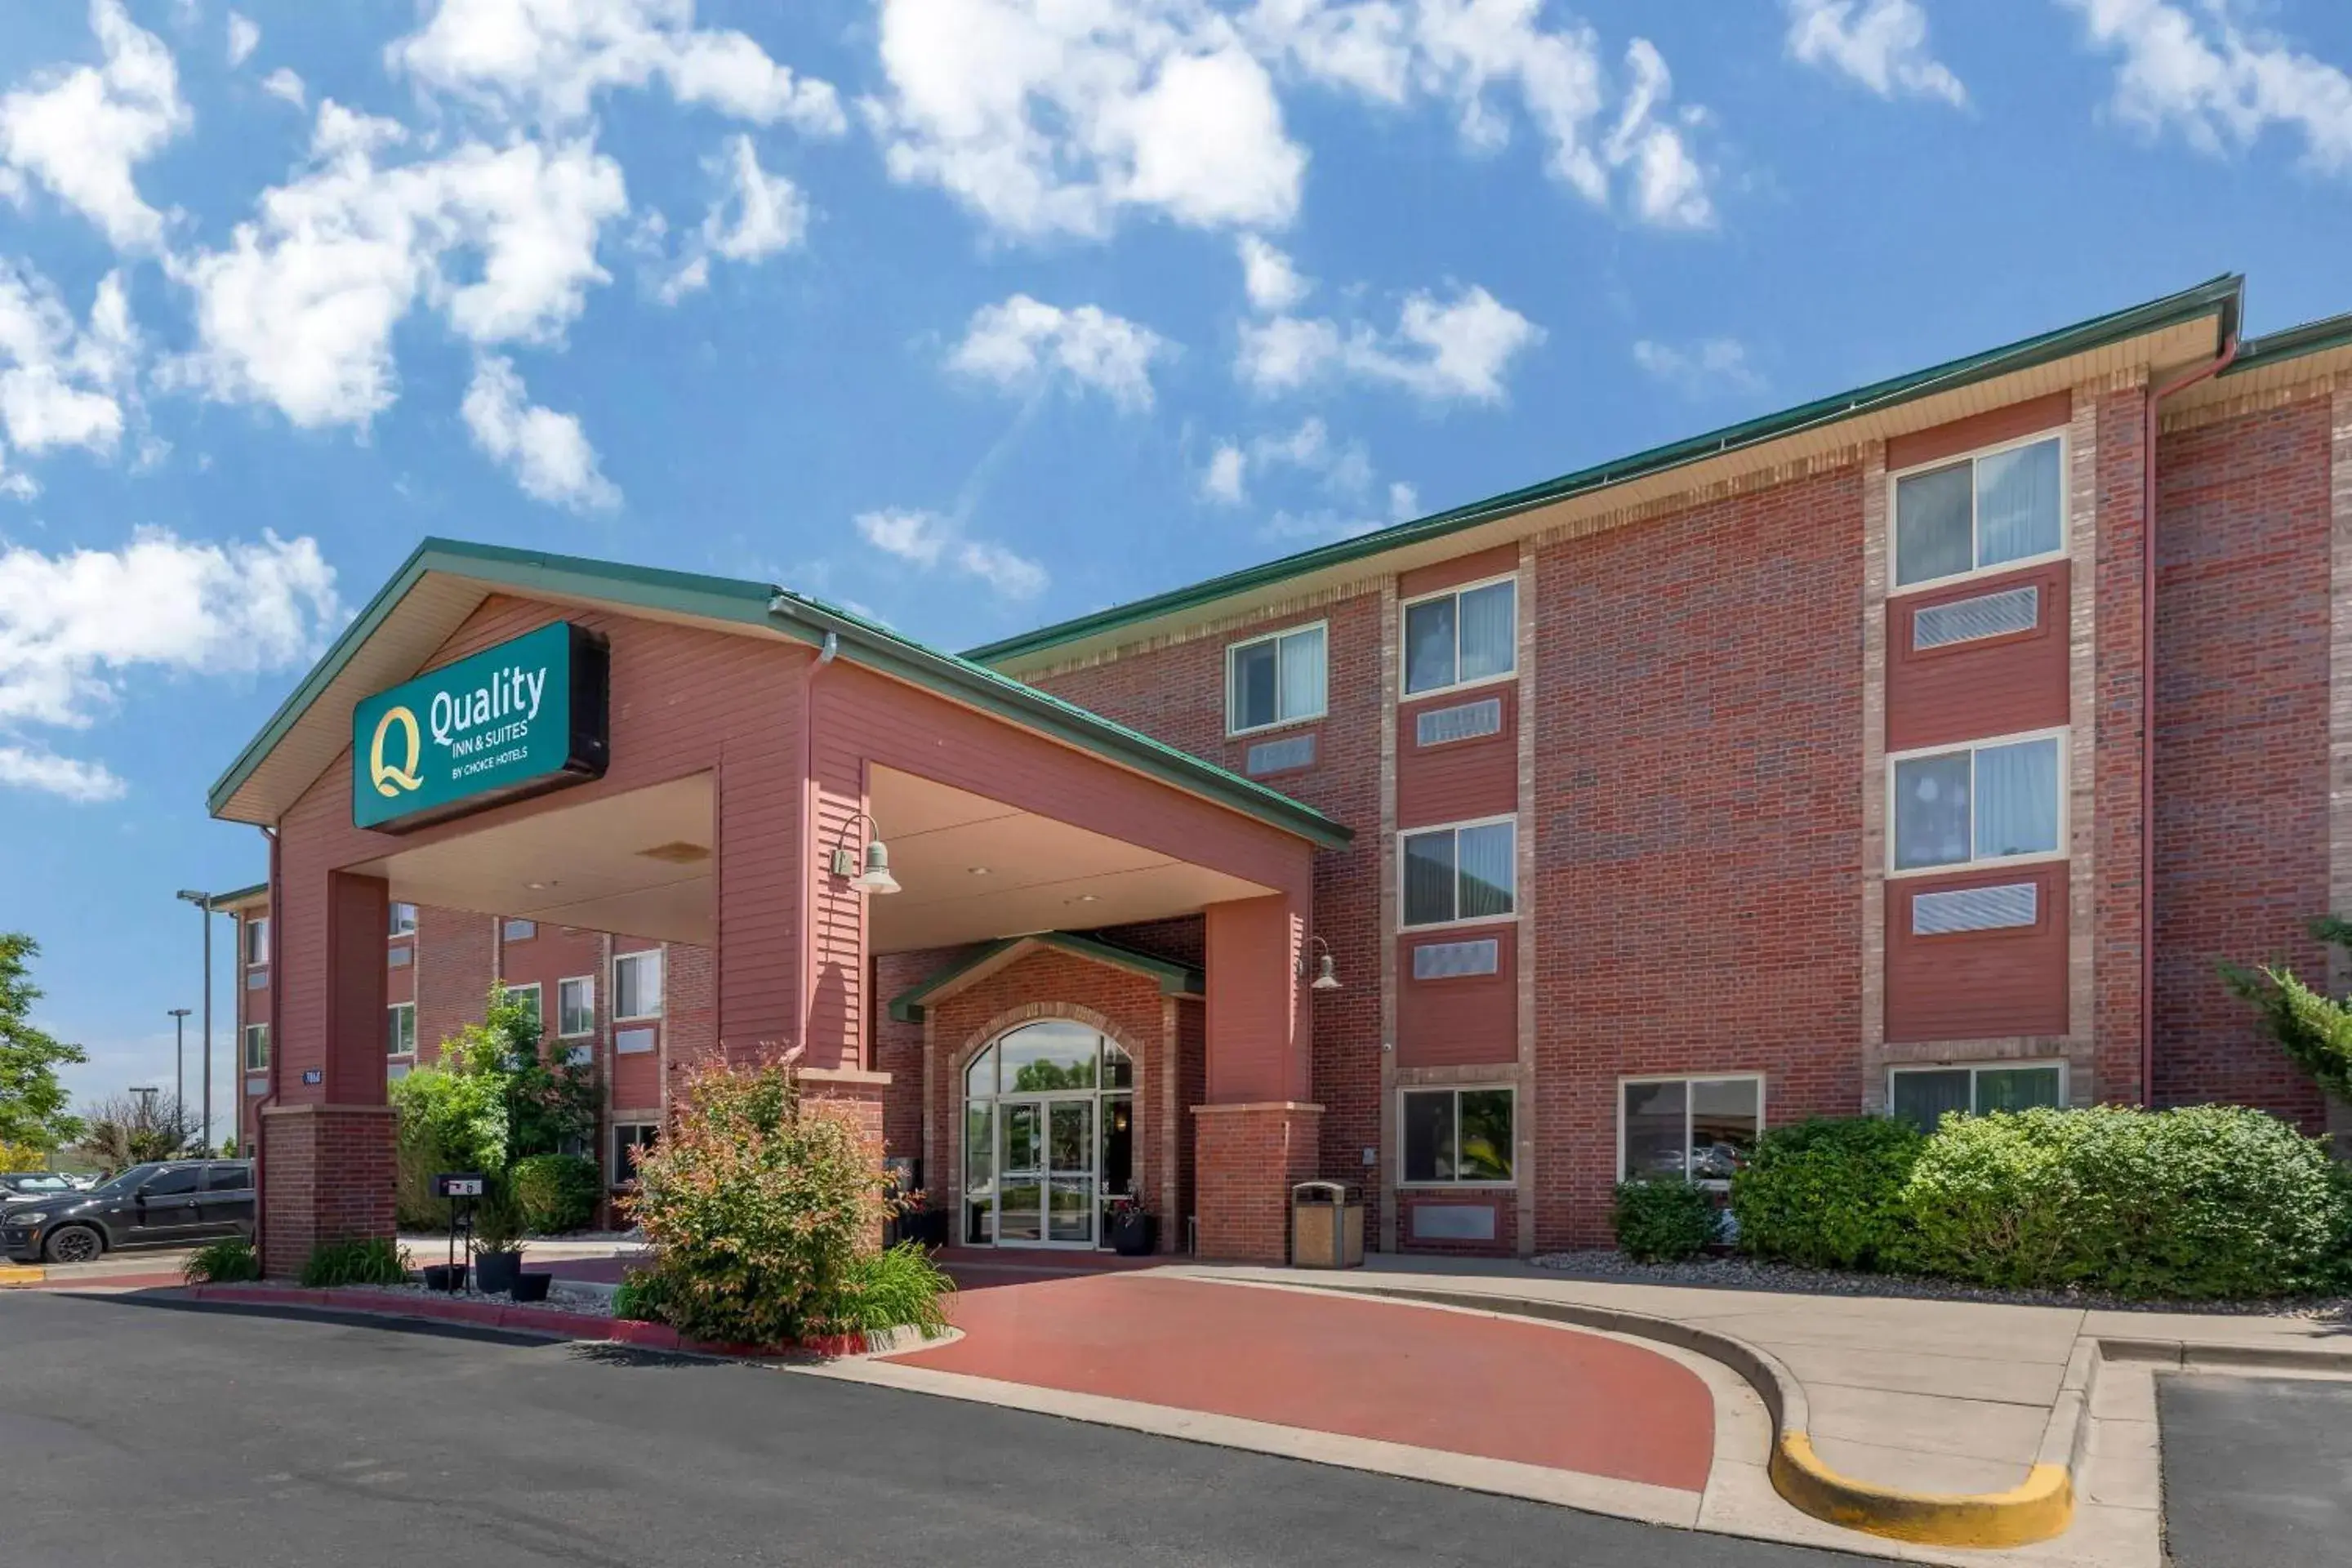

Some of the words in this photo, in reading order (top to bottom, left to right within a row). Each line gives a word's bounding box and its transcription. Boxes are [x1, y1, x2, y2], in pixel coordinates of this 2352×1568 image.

[430, 666, 546, 746] Quality
[371, 706, 424, 797] Q
[452, 737, 473, 760] INN
[475, 735, 484, 751] &
[485, 719, 528, 747] SUITES
[452, 766, 463, 780] BY
[464, 757, 494, 775] CHOICE
[496, 746, 528, 765] HOTELS
